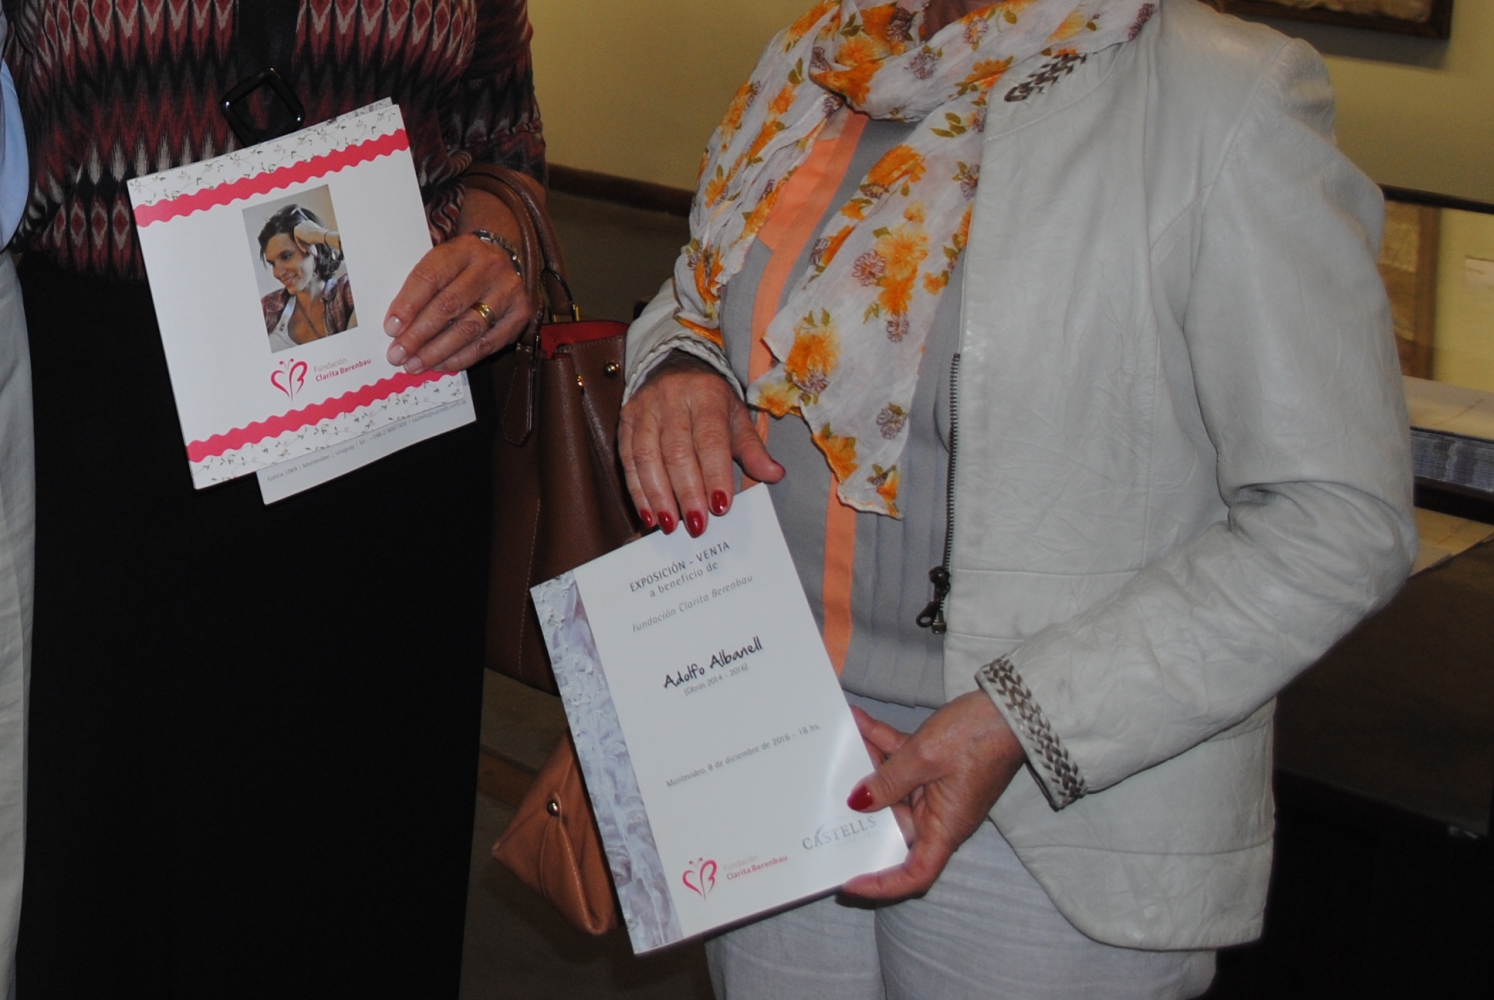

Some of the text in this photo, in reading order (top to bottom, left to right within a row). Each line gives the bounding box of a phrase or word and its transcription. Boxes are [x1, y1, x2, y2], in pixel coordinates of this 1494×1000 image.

[313, 358, 347, 373] Fundación
[315, 358, 372, 382] Clarita Berenbau
[629, 560, 686, 592] EXPOSICIÓN
[695, 541, 731, 562] VENTA
[649, 561, 718, 598] a beneficio de
[632, 575, 754, 633] Fundación Clarita Berenbau
[663, 635, 763, 689] Adolfo Albanell
[714, 759, 724, 769] de
[724, 746, 760, 765] diciembre
[761, 741, 770, 751] de
[772, 733, 791, 746] 2016
[802, 815, 877, 850] CASTELLS
[722, 855, 759, 872] Fundación
[726, 855, 789, 881] Clarita Berenbau
